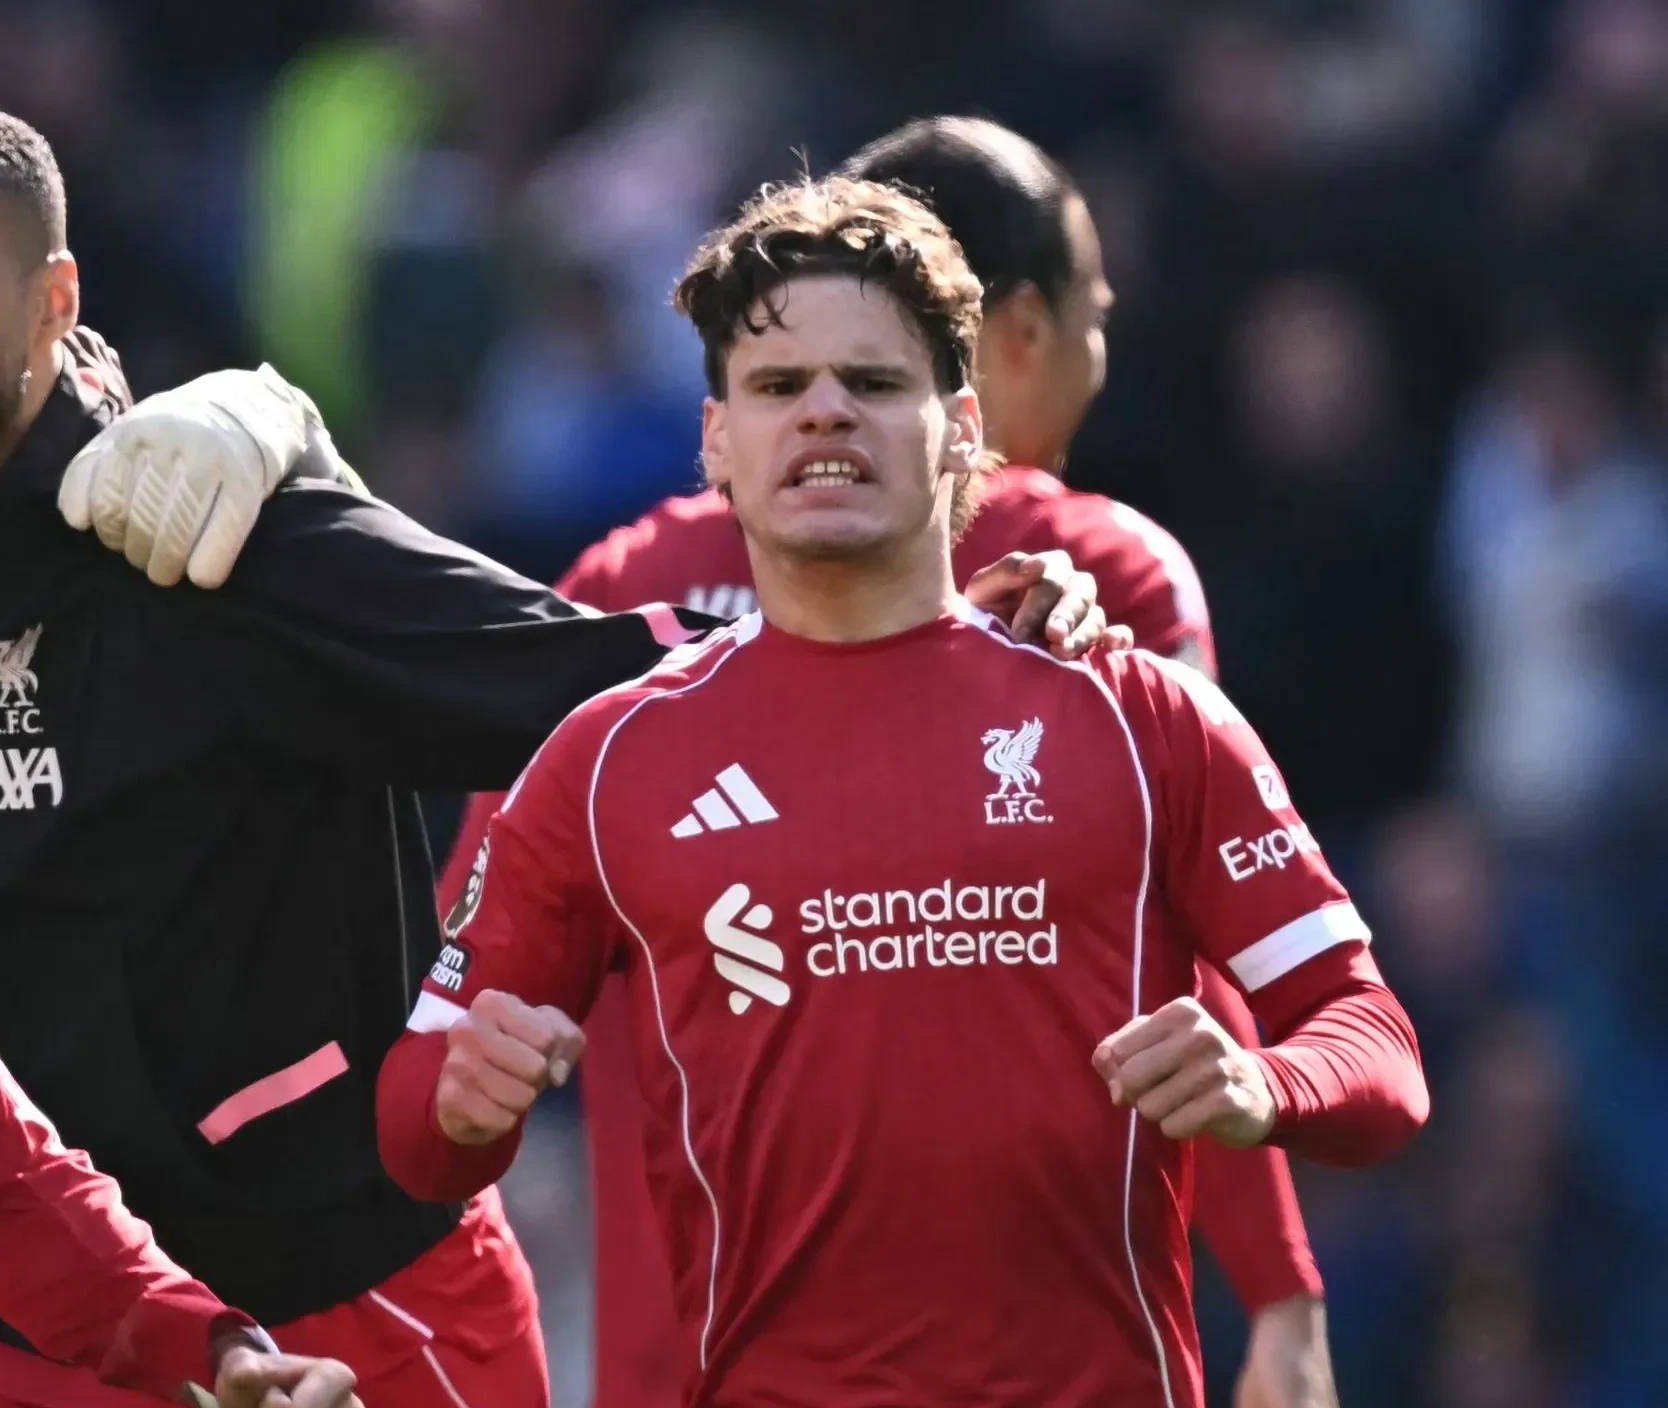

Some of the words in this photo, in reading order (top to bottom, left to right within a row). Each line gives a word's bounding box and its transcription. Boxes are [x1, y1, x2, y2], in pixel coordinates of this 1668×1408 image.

[984, 799, 1054, 825] L.F.C.
[800, 878, 1046, 934] standard
[807, 922, 1058, 977] chartered
